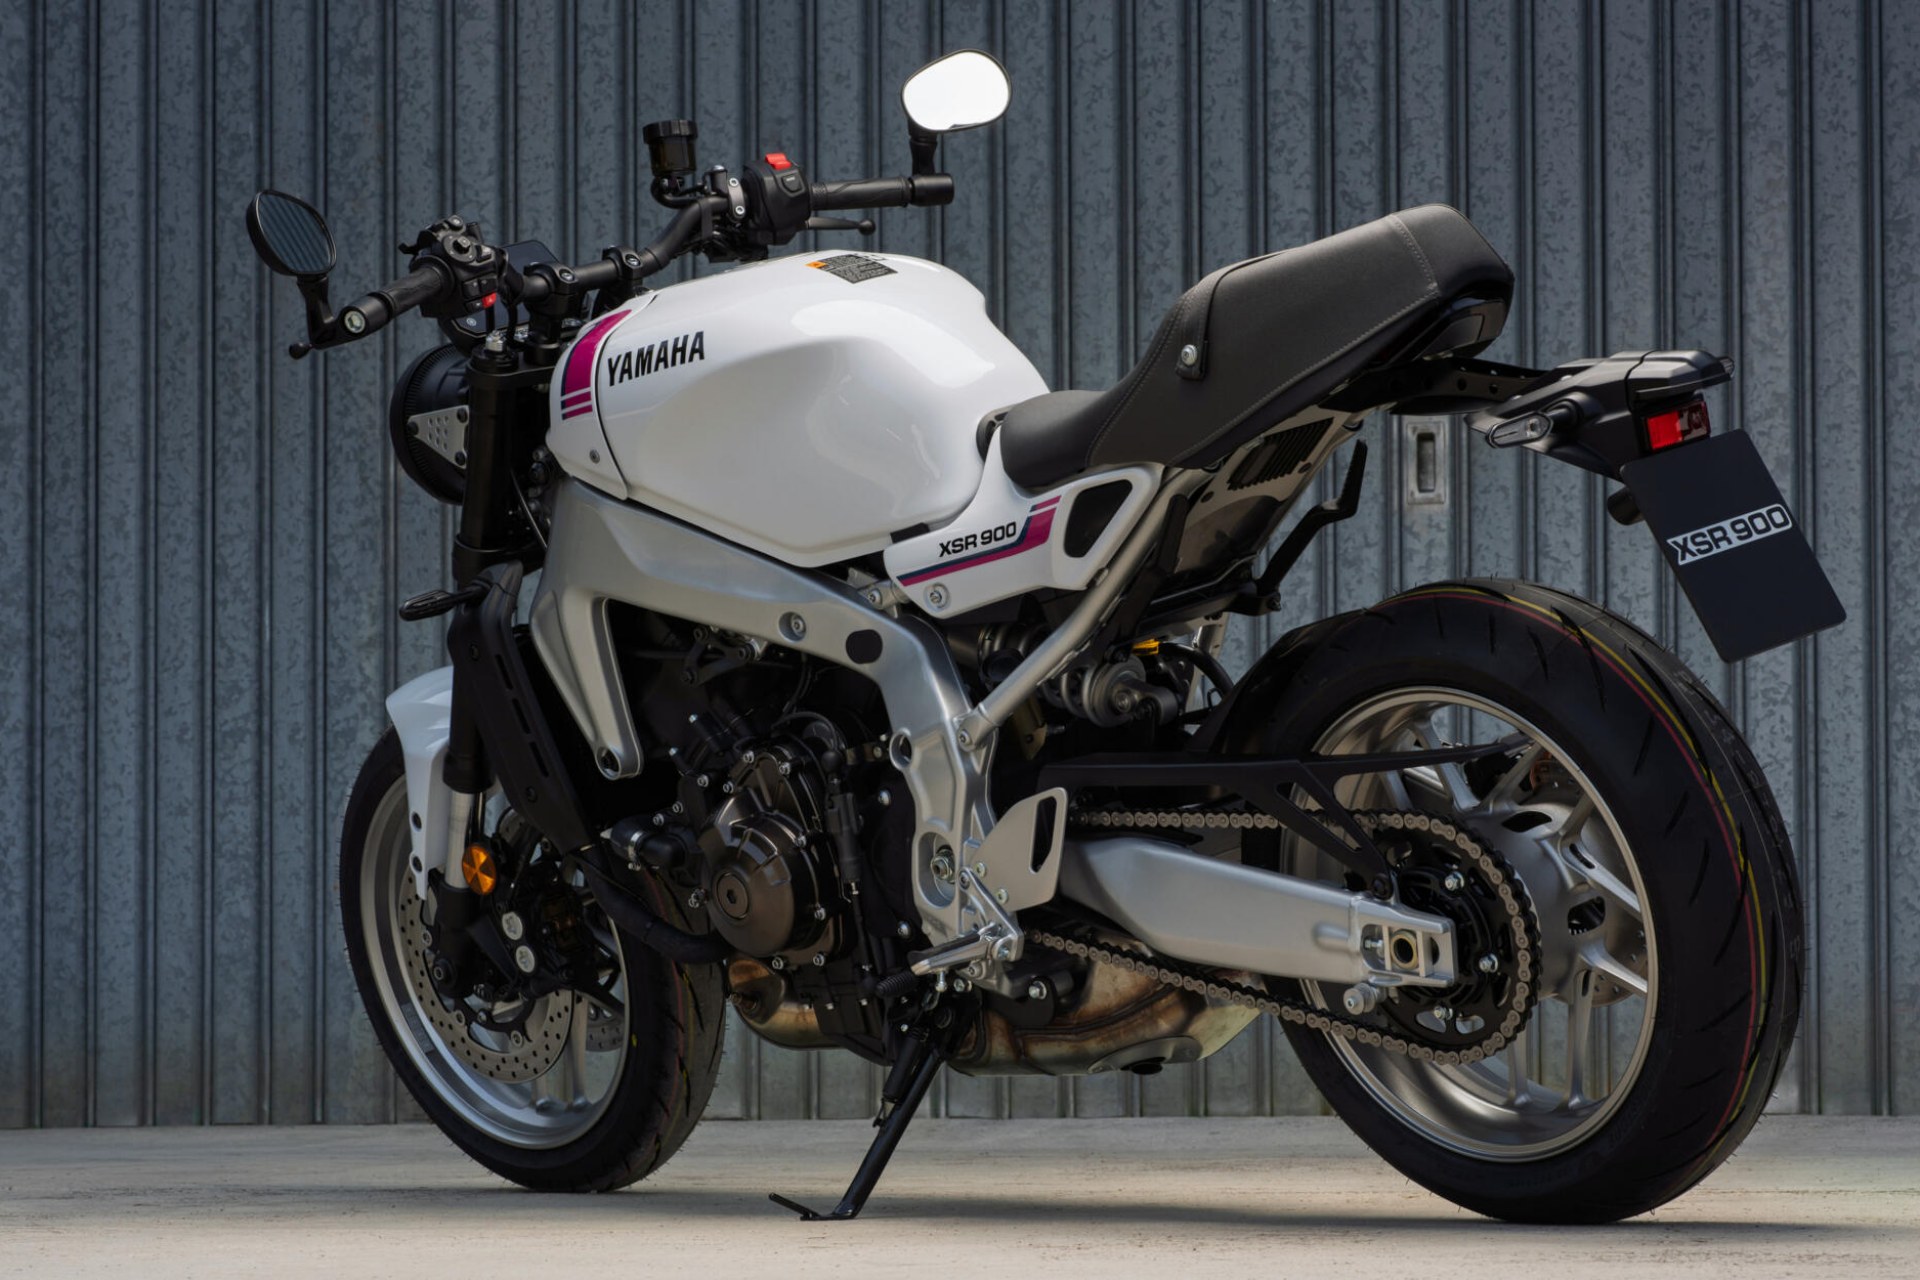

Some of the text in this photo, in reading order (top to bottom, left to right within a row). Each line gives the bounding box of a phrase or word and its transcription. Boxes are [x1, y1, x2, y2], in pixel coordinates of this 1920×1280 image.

[607, 331, 705, 387] YAMAHA
[938, 521, 1017, 557] XSR 900
[1671, 506, 1790, 561] XSR 900
